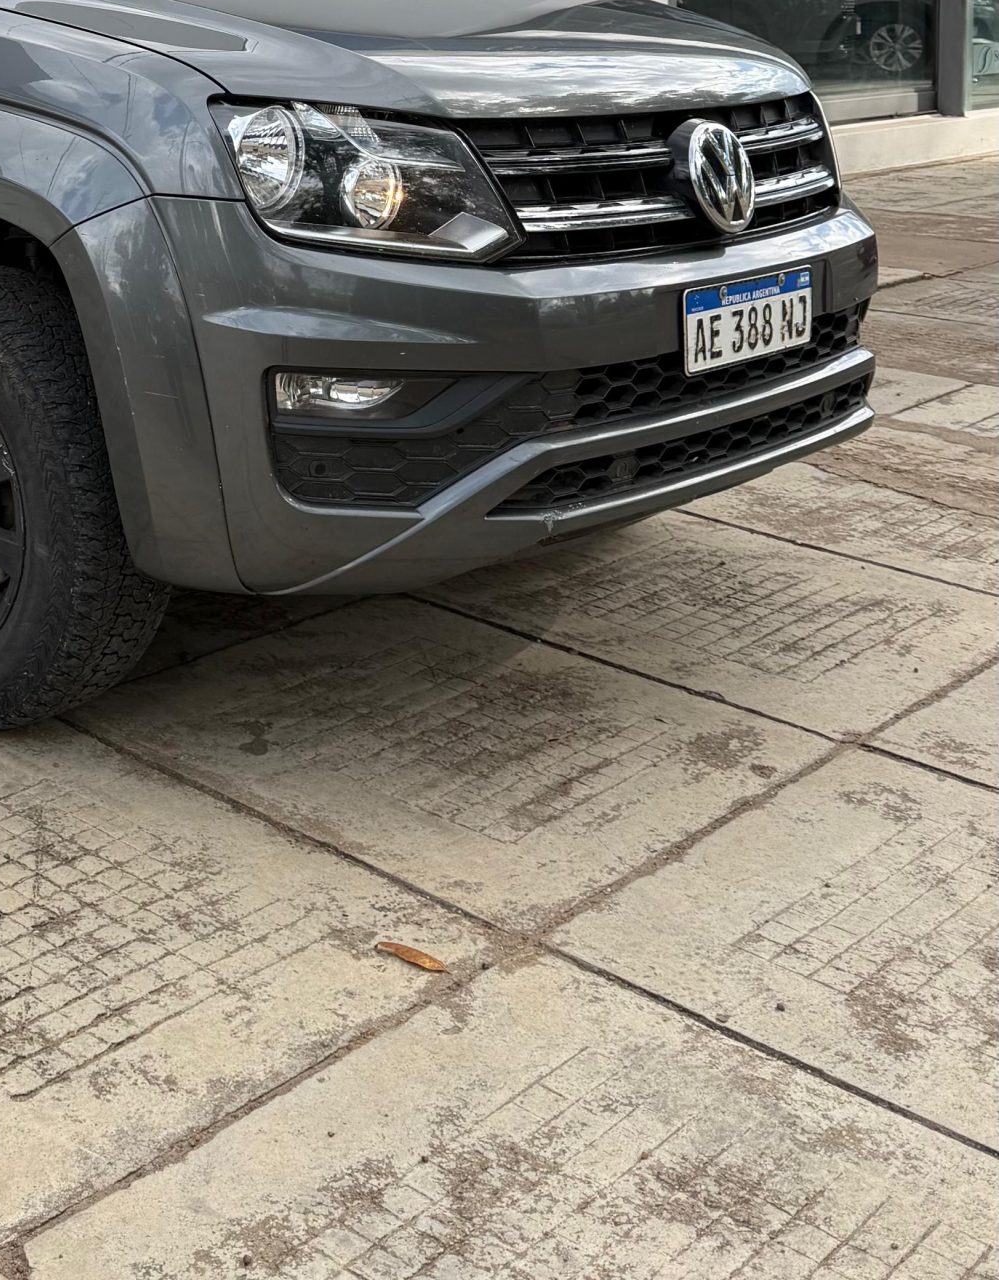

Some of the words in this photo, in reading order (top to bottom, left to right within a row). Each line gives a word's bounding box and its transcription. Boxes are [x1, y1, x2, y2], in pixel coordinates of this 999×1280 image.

[752, 285, 781, 300] ARGENTINA
[694, 314, 722, 363] AE
[732, 303, 773, 353] 388
[781, 295, 807, 342] NJ
